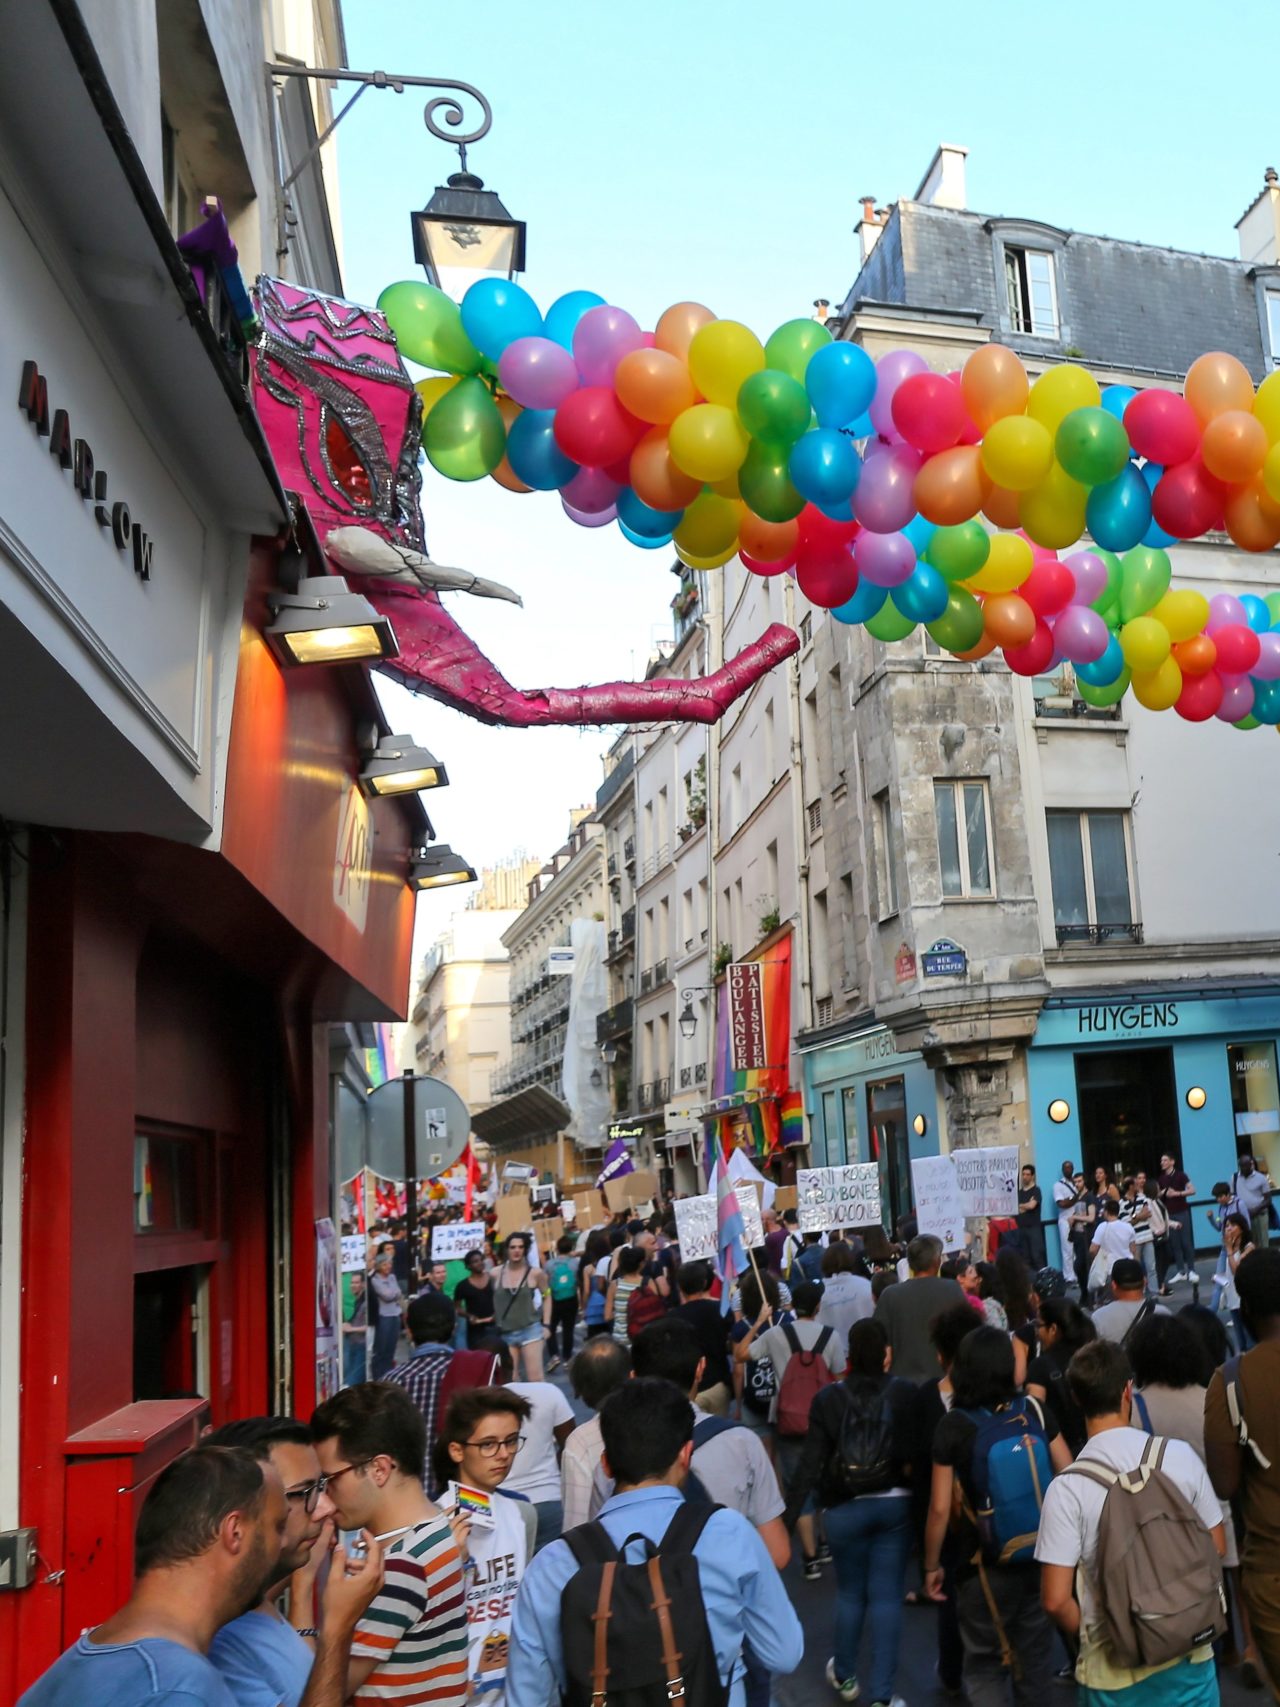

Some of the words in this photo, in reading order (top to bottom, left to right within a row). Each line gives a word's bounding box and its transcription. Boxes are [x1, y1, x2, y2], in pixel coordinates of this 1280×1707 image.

[936, 956, 951, 964] RUE
[938, 963, 963, 972] TEMPLE
[731, 966, 748, 1070] BOULANGER
[748, 965, 763, 1068] PATISSIER
[1078, 1003, 1178, 1033] HUYGENS
[1235, 1060, 1270, 1071] HUYGENS
[842, 1165, 880, 1183] ROSAS
[472, 1553, 516, 1587] LIFE
[466, 1589, 488, 1601] can
